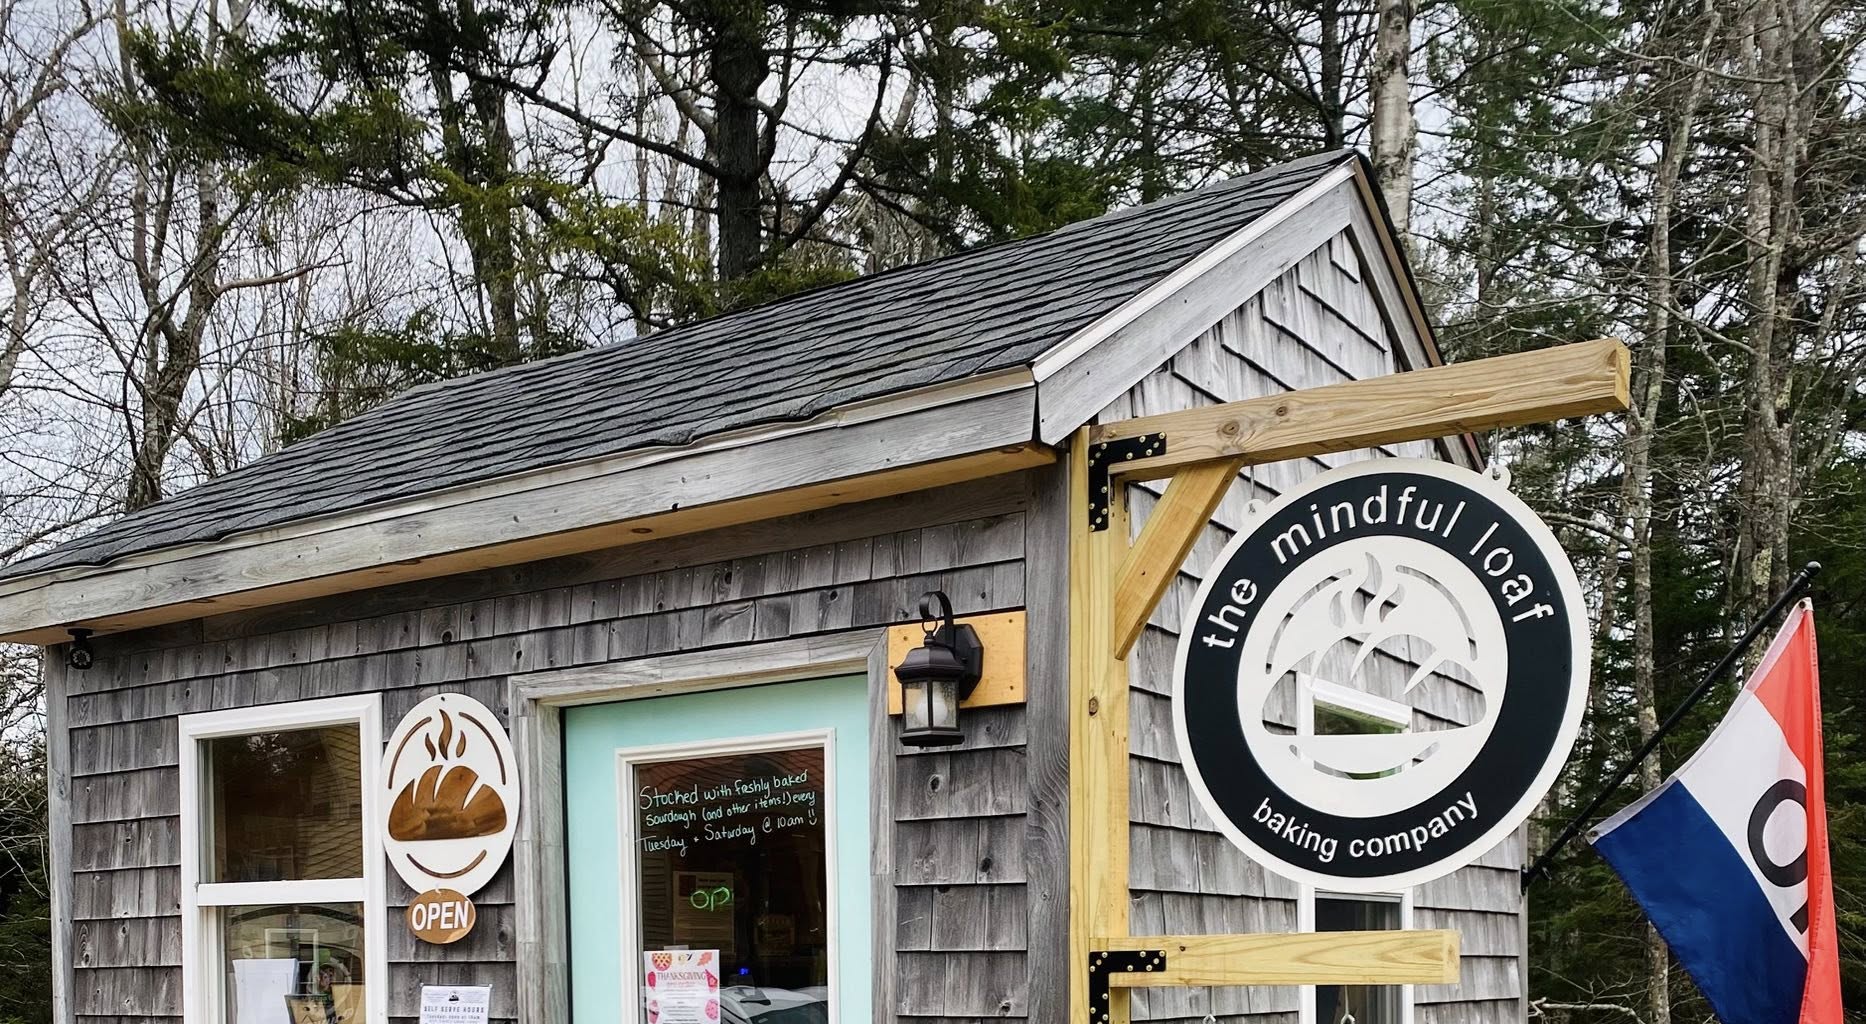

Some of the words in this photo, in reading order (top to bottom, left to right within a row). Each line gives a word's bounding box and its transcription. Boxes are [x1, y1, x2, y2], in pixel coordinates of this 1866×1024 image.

[1202, 577, 1259, 649] the
[1270, 485, 1466, 564] mindful
[1469, 521, 1556, 624] loaf
[640, 783, 699, 810] Stocked
[703, 784, 732, 800] with
[773, 768, 808, 788] baked
[726, 802, 751, 817] other
[792, 791, 816, 806] every
[636, 835, 688, 857] Tuesday
[704, 823, 756, 846] Saturday
[762, 816, 773, 833] @
[1252, 797, 1339, 863] baking
[1348, 791, 1480, 859] company
[411, 900, 469, 931] OPEN
[656, 971, 707, 981] THANKSGIVING
